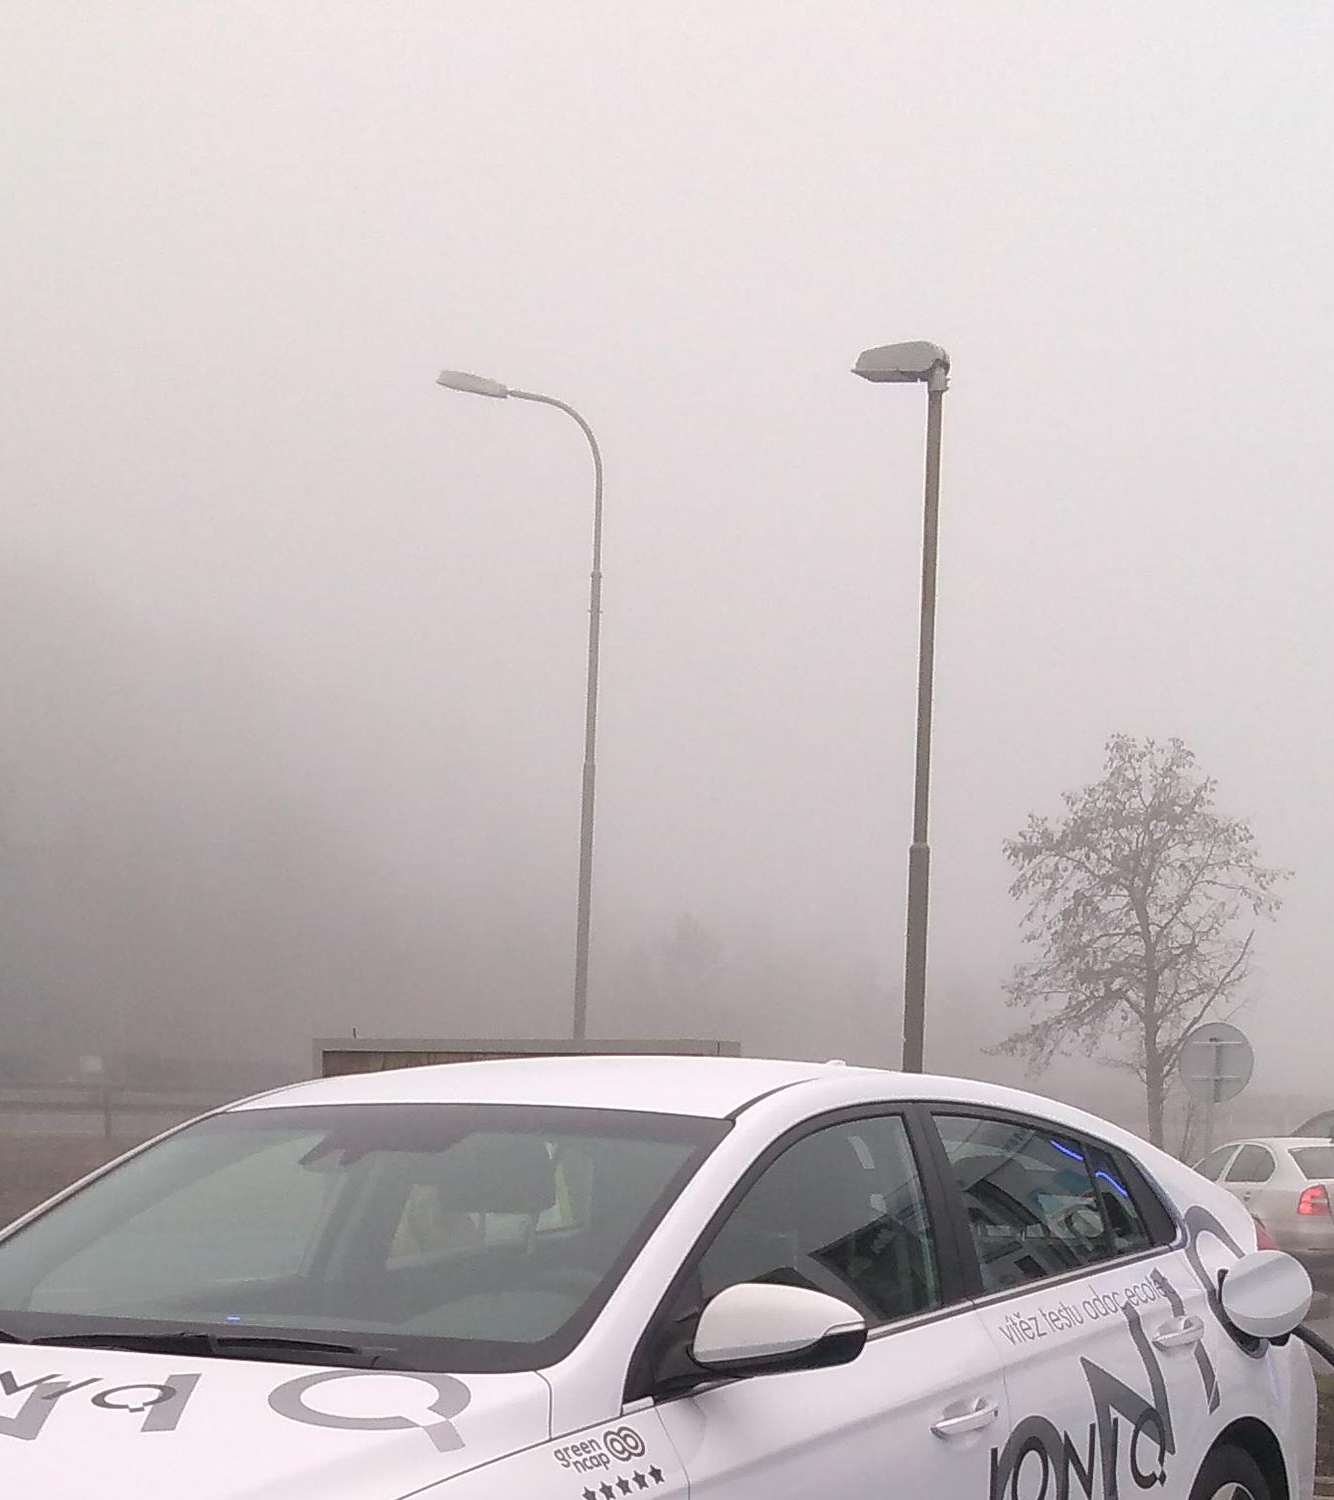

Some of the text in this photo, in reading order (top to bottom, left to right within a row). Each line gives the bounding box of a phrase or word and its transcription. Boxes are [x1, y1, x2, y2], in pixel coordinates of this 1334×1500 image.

[1082, 1284, 1127, 1322] adac
[553, 1437, 603, 1469] green
[573, 1452, 611, 1474] ncap
